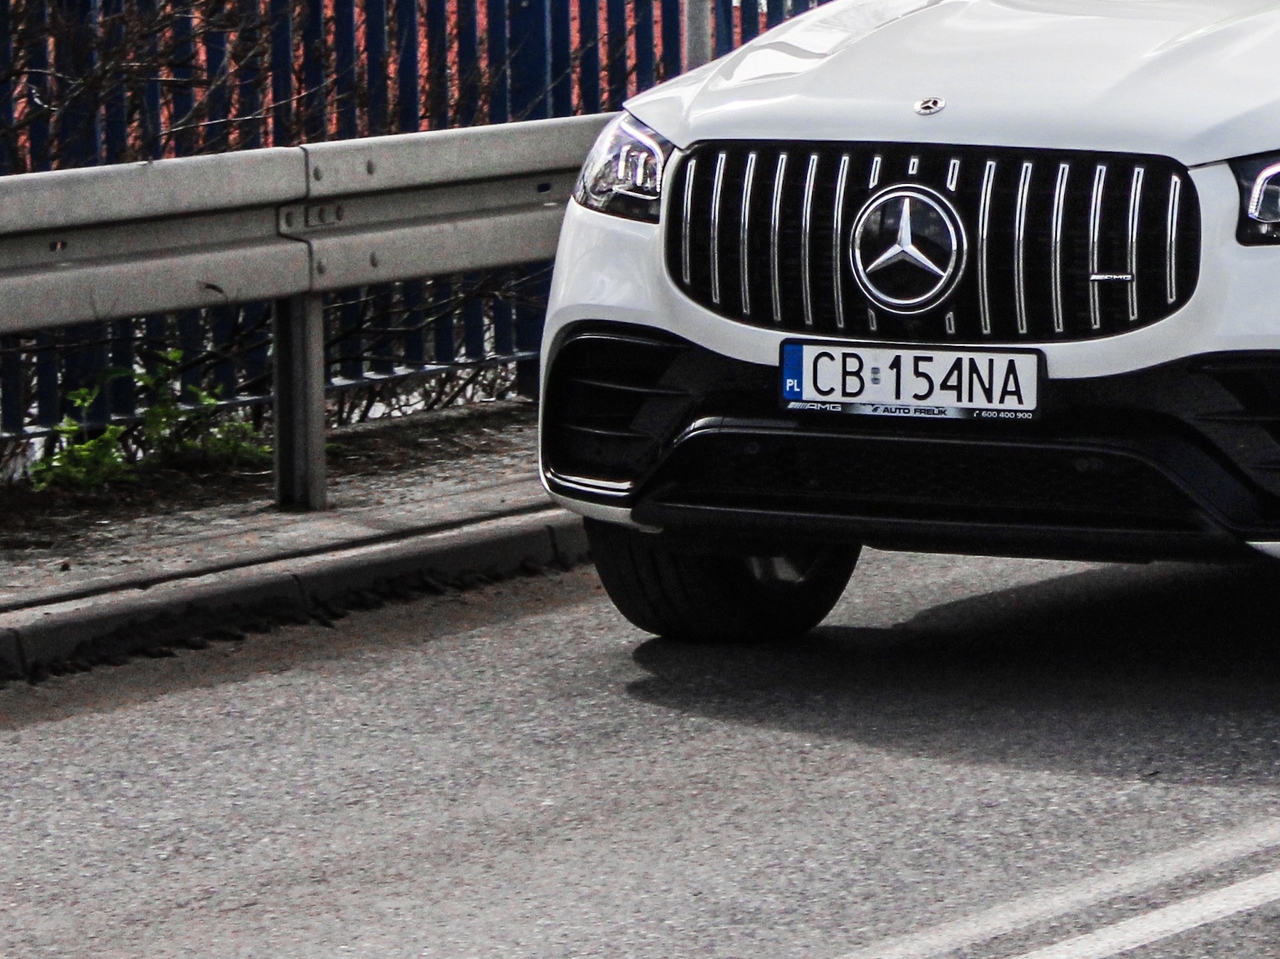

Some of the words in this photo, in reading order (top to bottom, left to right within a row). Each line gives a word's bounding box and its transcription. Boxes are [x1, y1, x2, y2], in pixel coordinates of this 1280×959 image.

[812, 351, 865, 398] CB
[888, 354, 1024, 405] 154NA
[786, 379, 800, 392] PL
[806, 402, 842, 412] AMG
[882, 406, 911, 415] AUTO
[981, 410, 998, 418] 600
[998, 411, 1016, 419] 400
